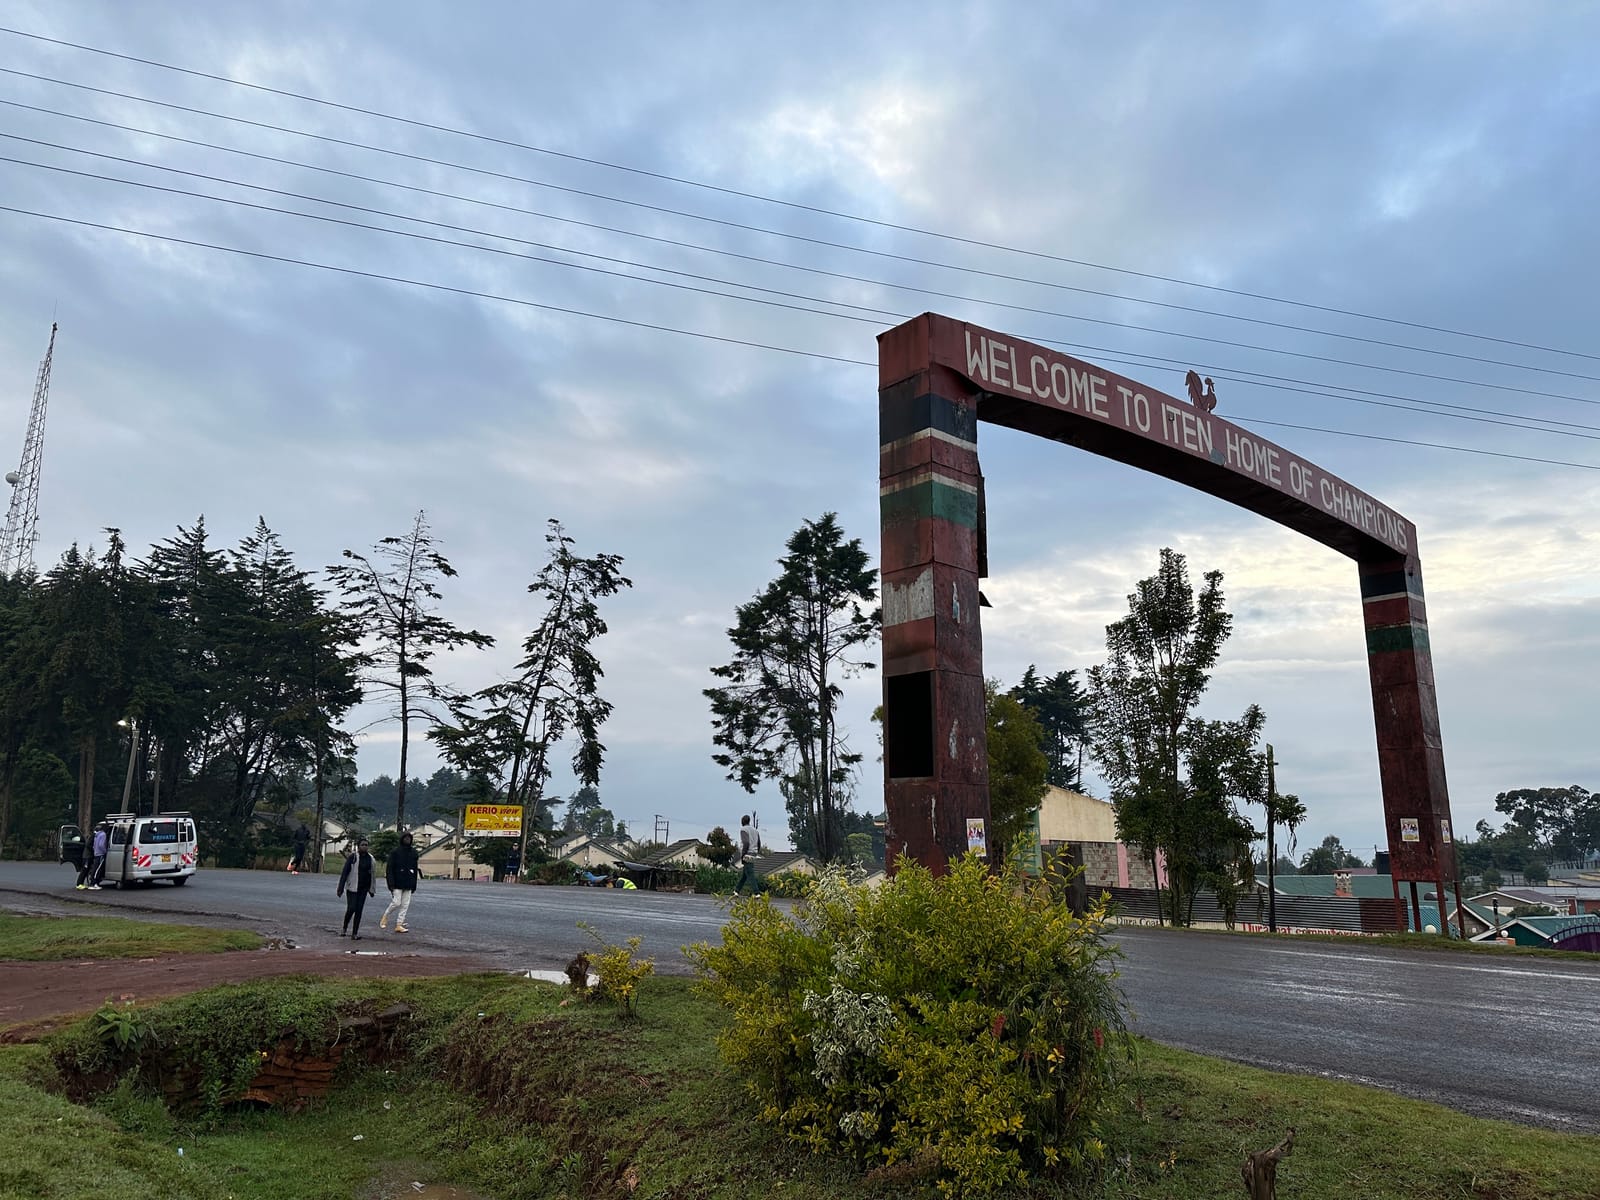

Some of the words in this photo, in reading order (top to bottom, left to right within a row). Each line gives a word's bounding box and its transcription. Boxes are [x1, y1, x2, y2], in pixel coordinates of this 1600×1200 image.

[965, 330, 1109, 419] WELCOME
[1117, 384, 1151, 433] TO
[1161, 402, 1214, 454] ITEN
[1225, 428, 1282, 487] HOME
[1289, 460, 1313, 499] OF
[1320, 478, 1408, 550] CHAMPIONS
[470, 806, 498, 815] KERIO
